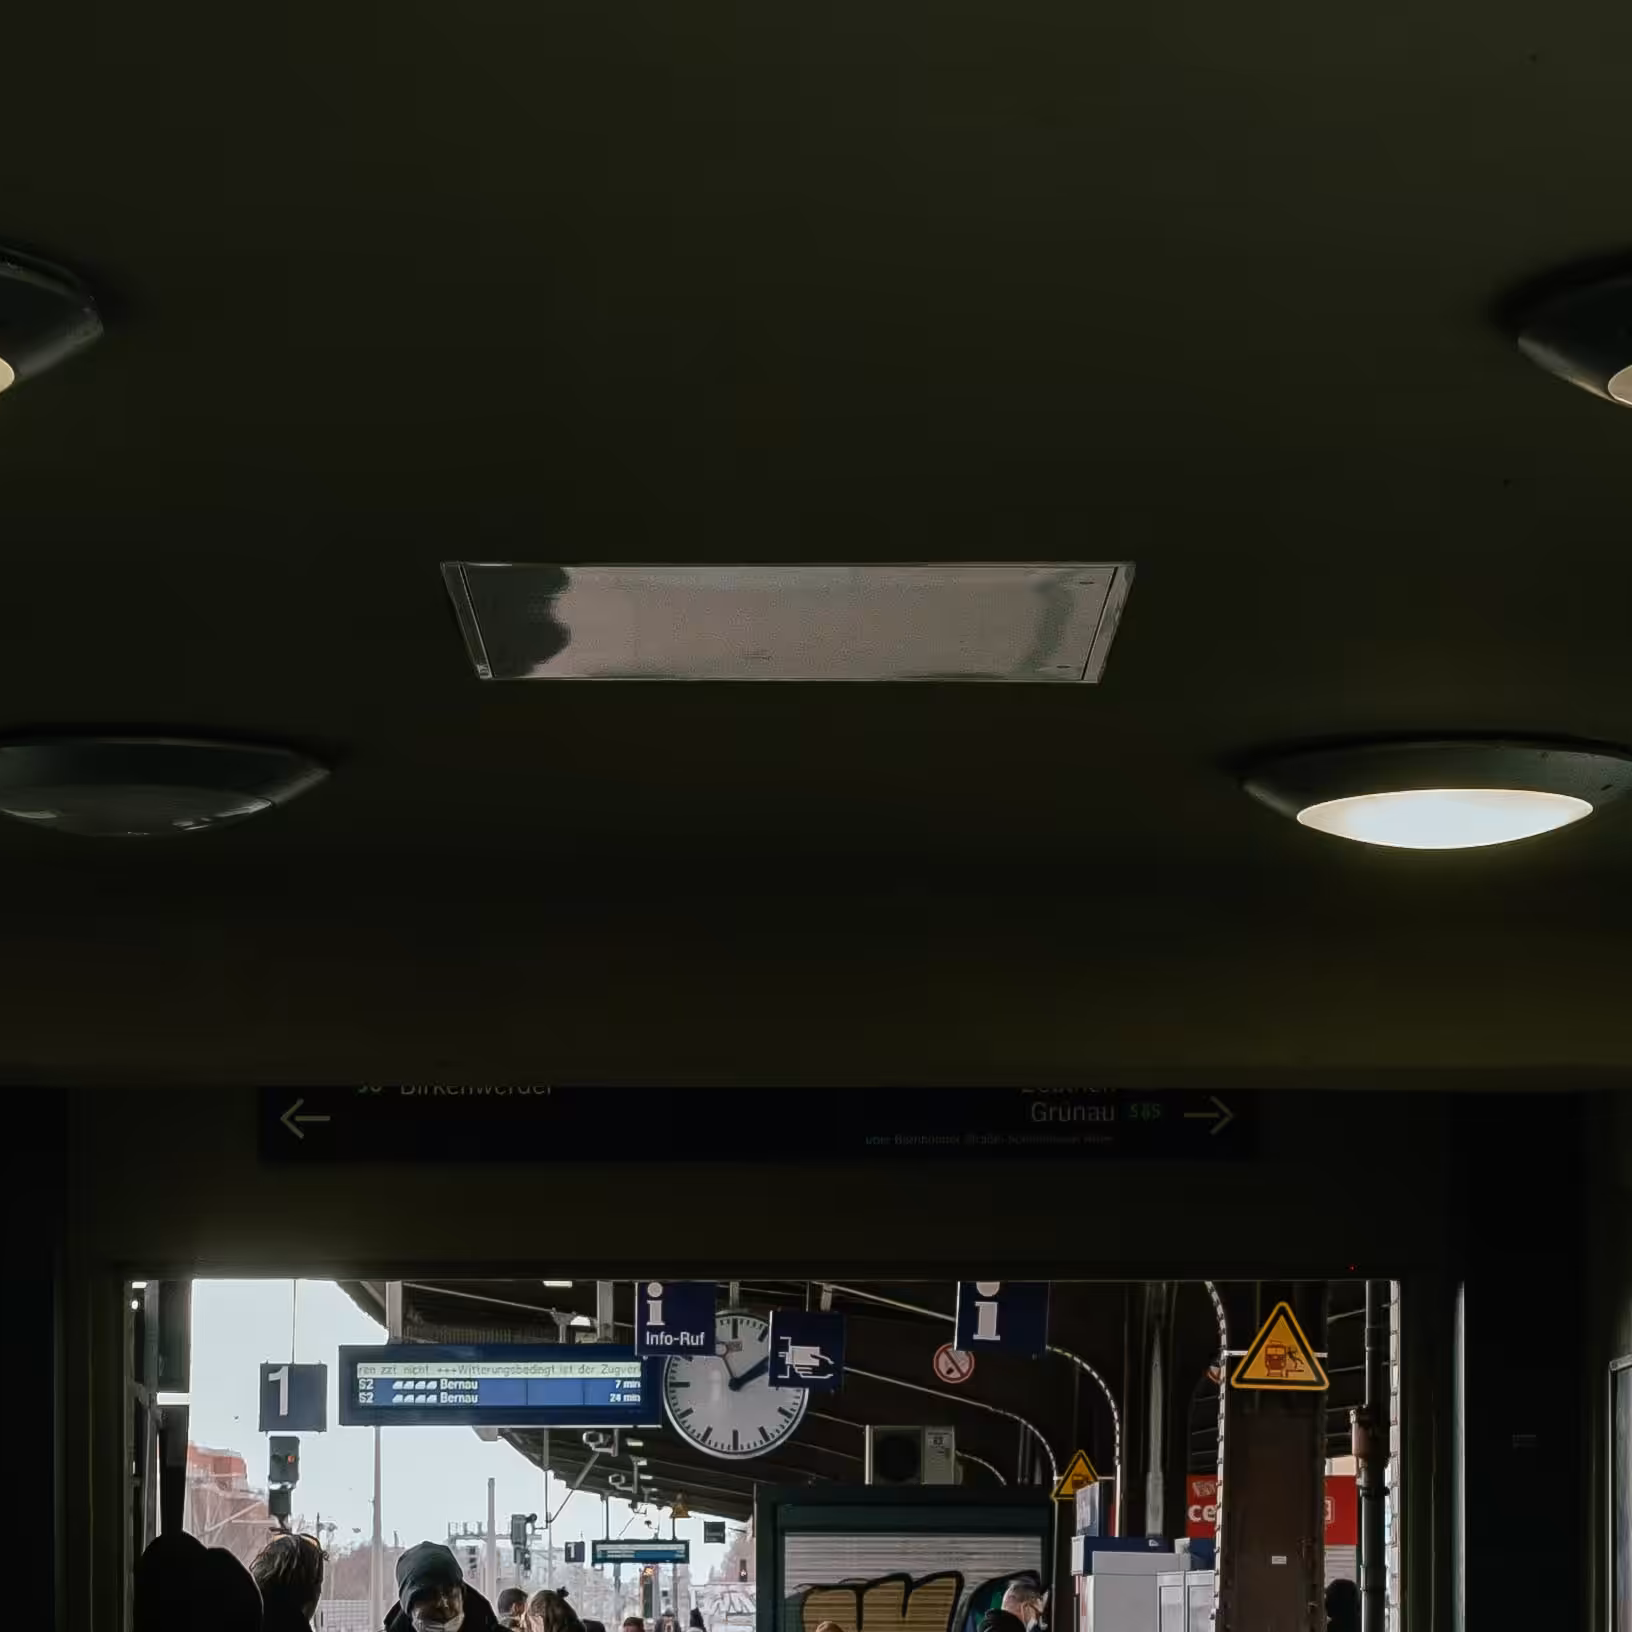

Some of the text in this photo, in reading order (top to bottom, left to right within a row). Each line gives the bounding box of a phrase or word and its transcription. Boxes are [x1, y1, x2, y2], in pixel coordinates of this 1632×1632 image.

[1030, 1101, 1115, 1122] Grünau
[646, 1331, 706, 1346] Info-Ruf
[578, 1364, 595, 1375] der
[268, 1366, 289, 1417] 1
[359, 1378, 641, 1390] S2 Bernau 7 min
[359, 1391, 641, 1403] S2 Bernau 24 min
[1187, 1504, 1217, 1522] ce
[567, 1543, 575, 1559] 1
